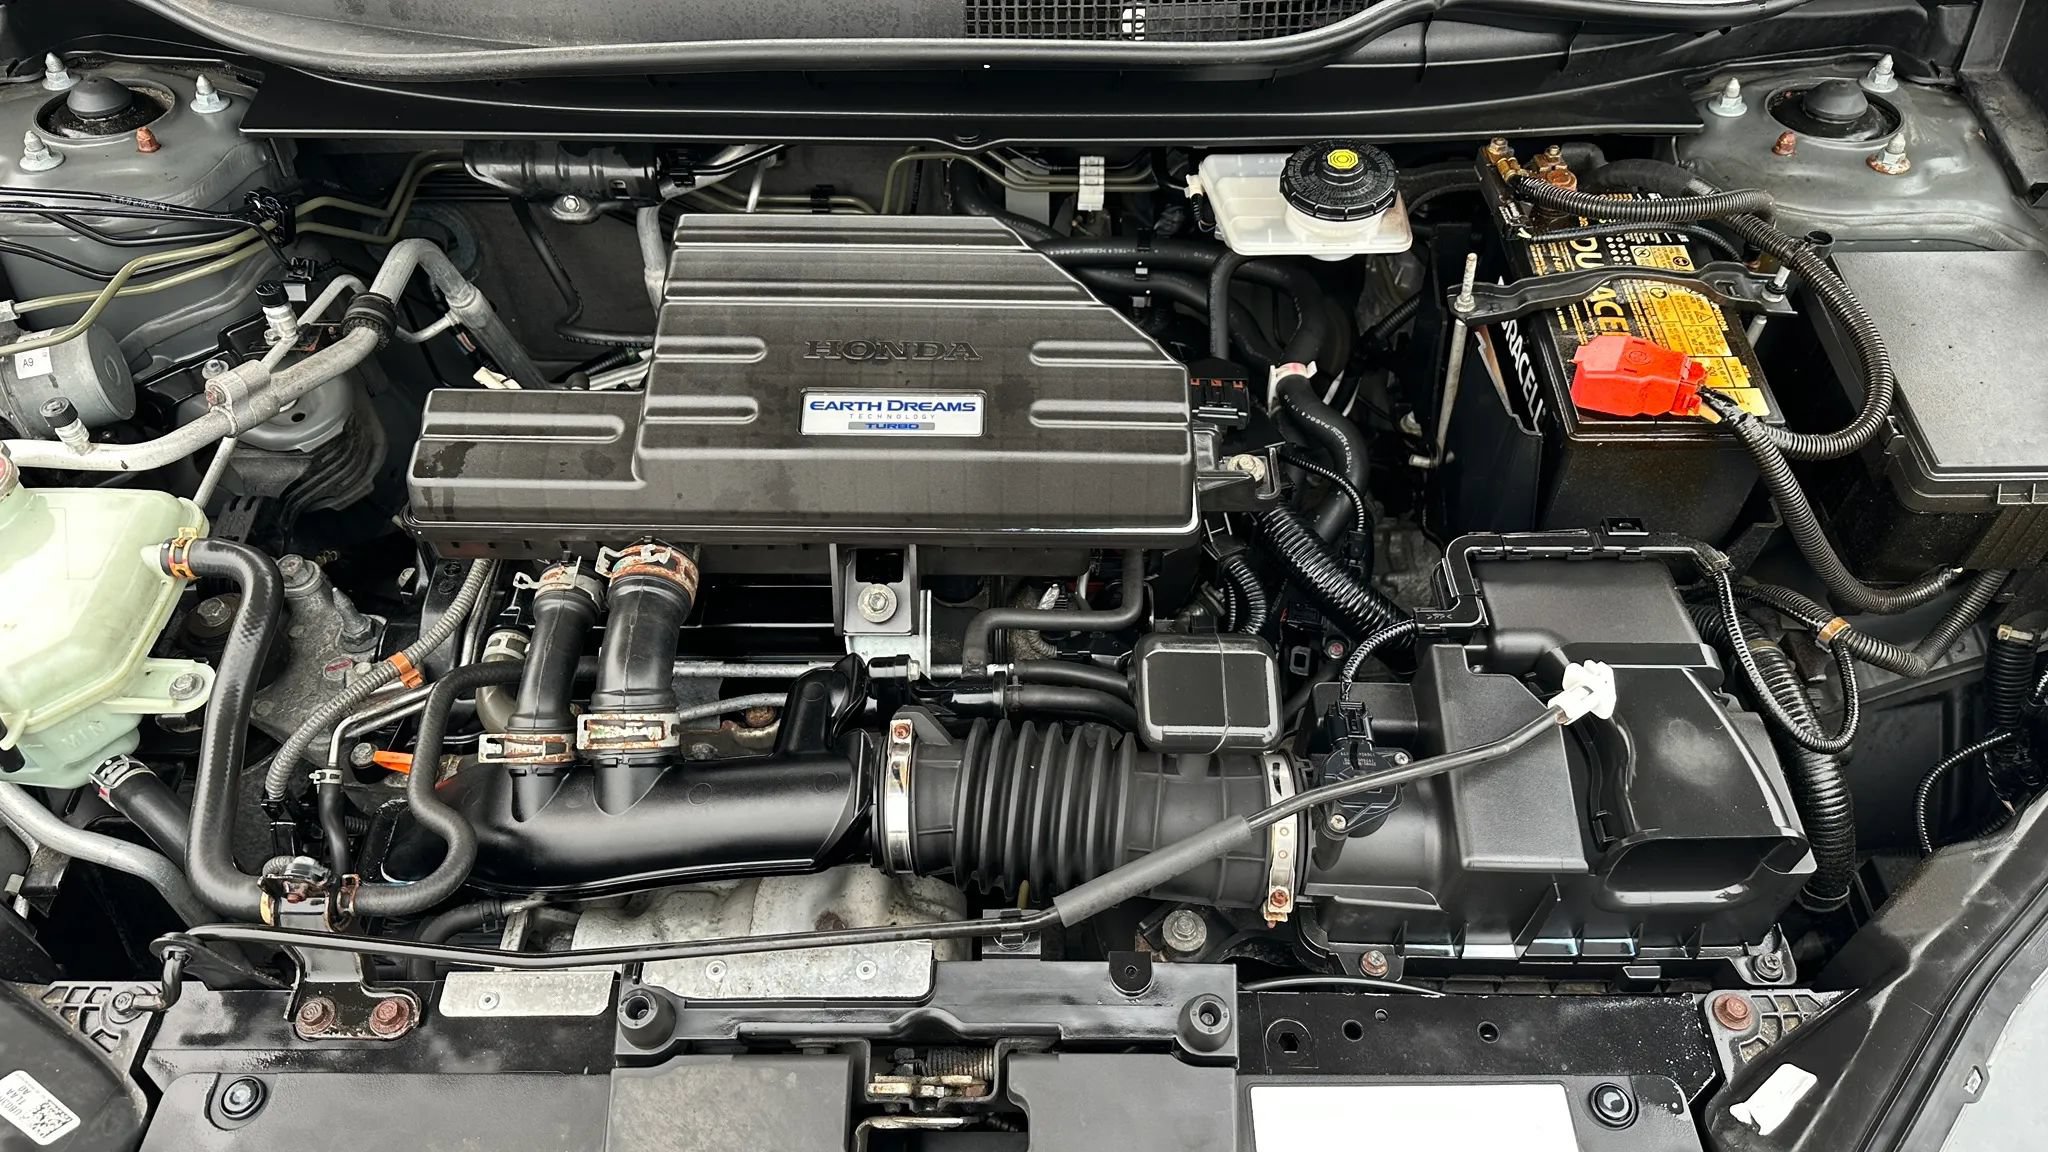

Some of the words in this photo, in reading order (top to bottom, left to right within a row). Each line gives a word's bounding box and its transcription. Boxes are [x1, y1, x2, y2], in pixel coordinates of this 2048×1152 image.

[803, 340, 983, 361] HONDA
[23, 358, 34, 367] A9
[810, 400, 882, 411] EARTH
[887, 400, 976, 412] DREAMS
